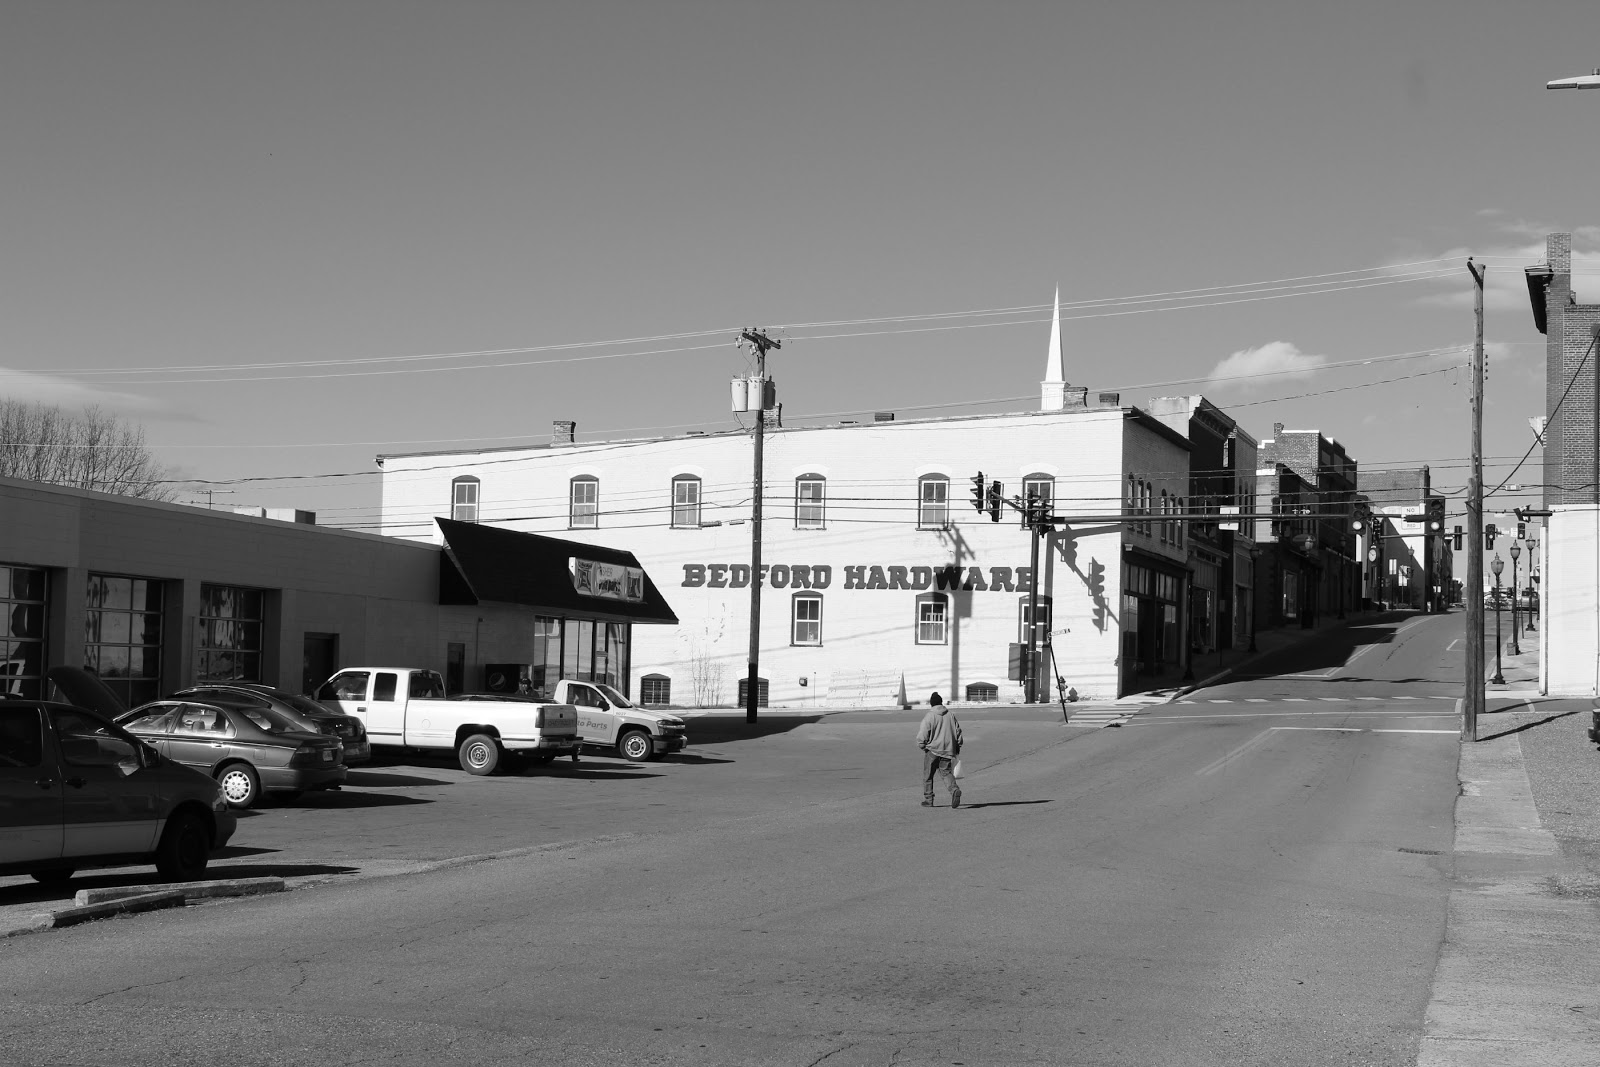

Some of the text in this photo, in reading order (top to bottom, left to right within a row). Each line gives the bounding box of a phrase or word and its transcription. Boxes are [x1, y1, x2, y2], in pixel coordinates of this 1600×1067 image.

[681, 563, 1036, 592] BEDFORD HARDWARE
[586, 720, 608, 730] Parts
